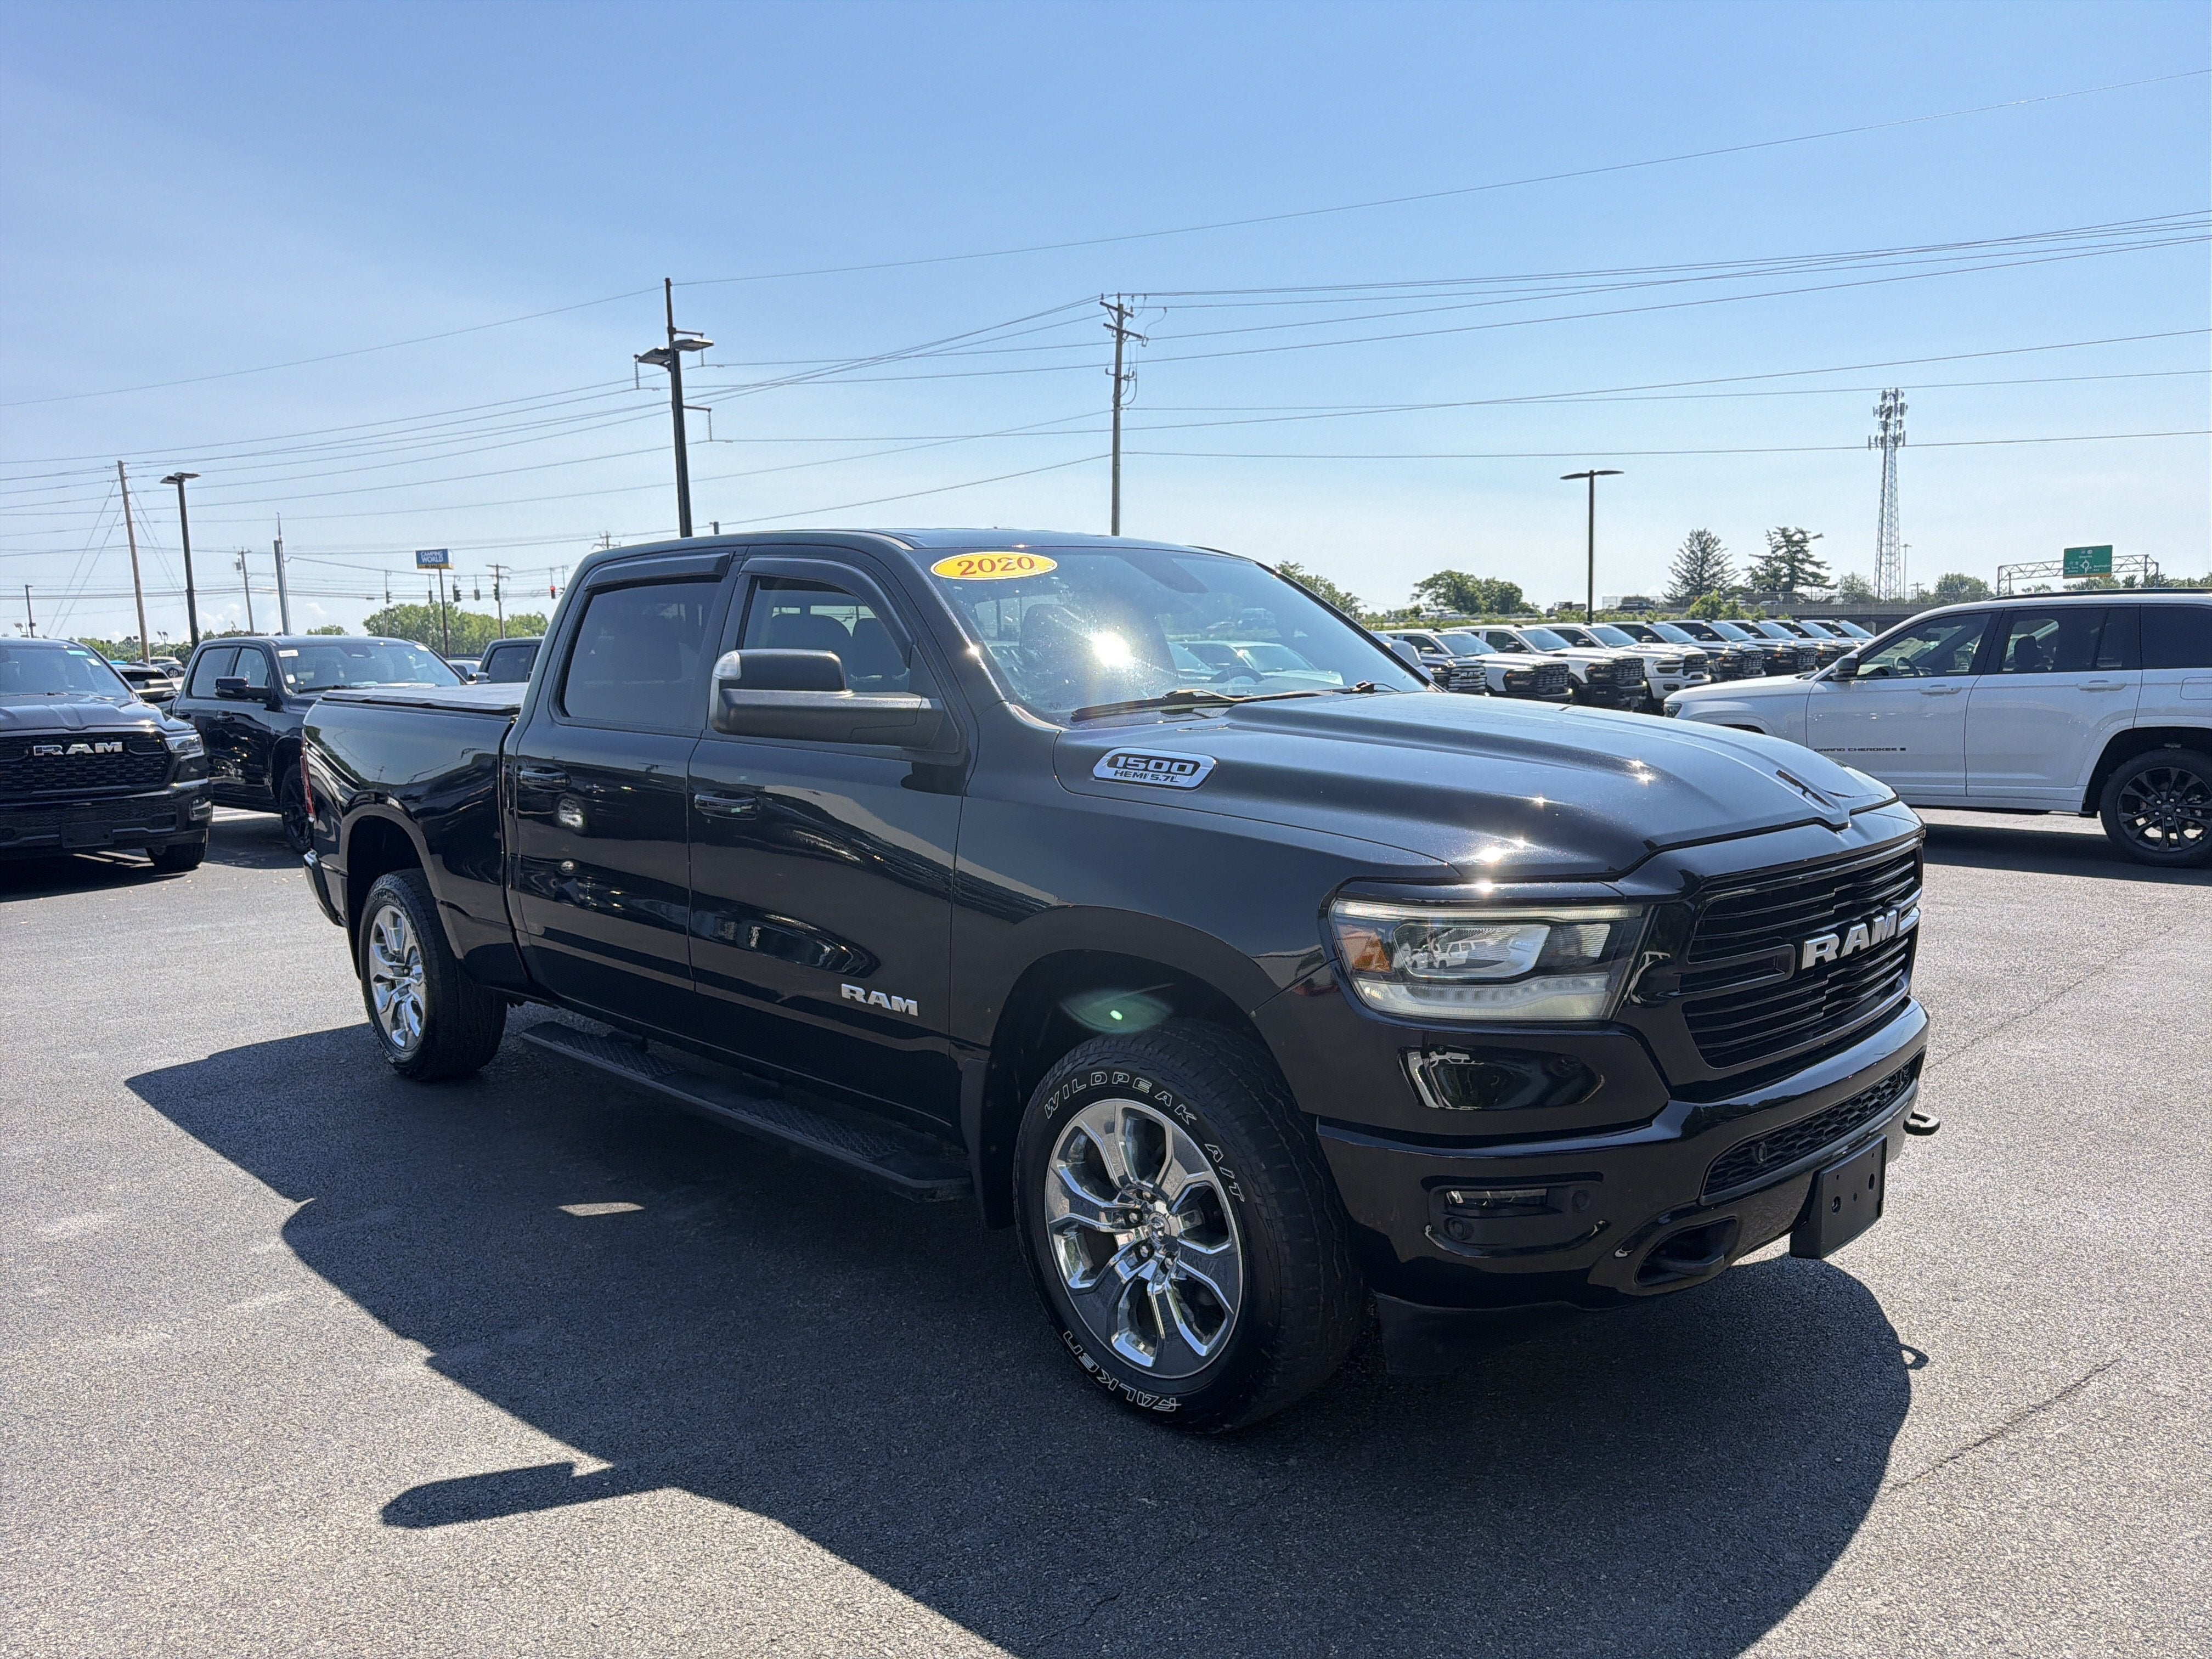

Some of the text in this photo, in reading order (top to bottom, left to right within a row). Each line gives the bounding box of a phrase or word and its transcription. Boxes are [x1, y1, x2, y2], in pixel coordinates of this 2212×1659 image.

[957, 556, 1035, 576] 2020
[33, 742, 123, 756] RAM
[1114, 770, 1180, 783] HEMI 5.7L
[1116, 756, 1194, 775] 1500
[1802, 909, 1897, 970] RAM
[841, 983, 918, 1017] RAM
[1044, 1071, 1246, 1203] WILDPEAK A/T
[1063, 1330, 1182, 1412] FALKEN
